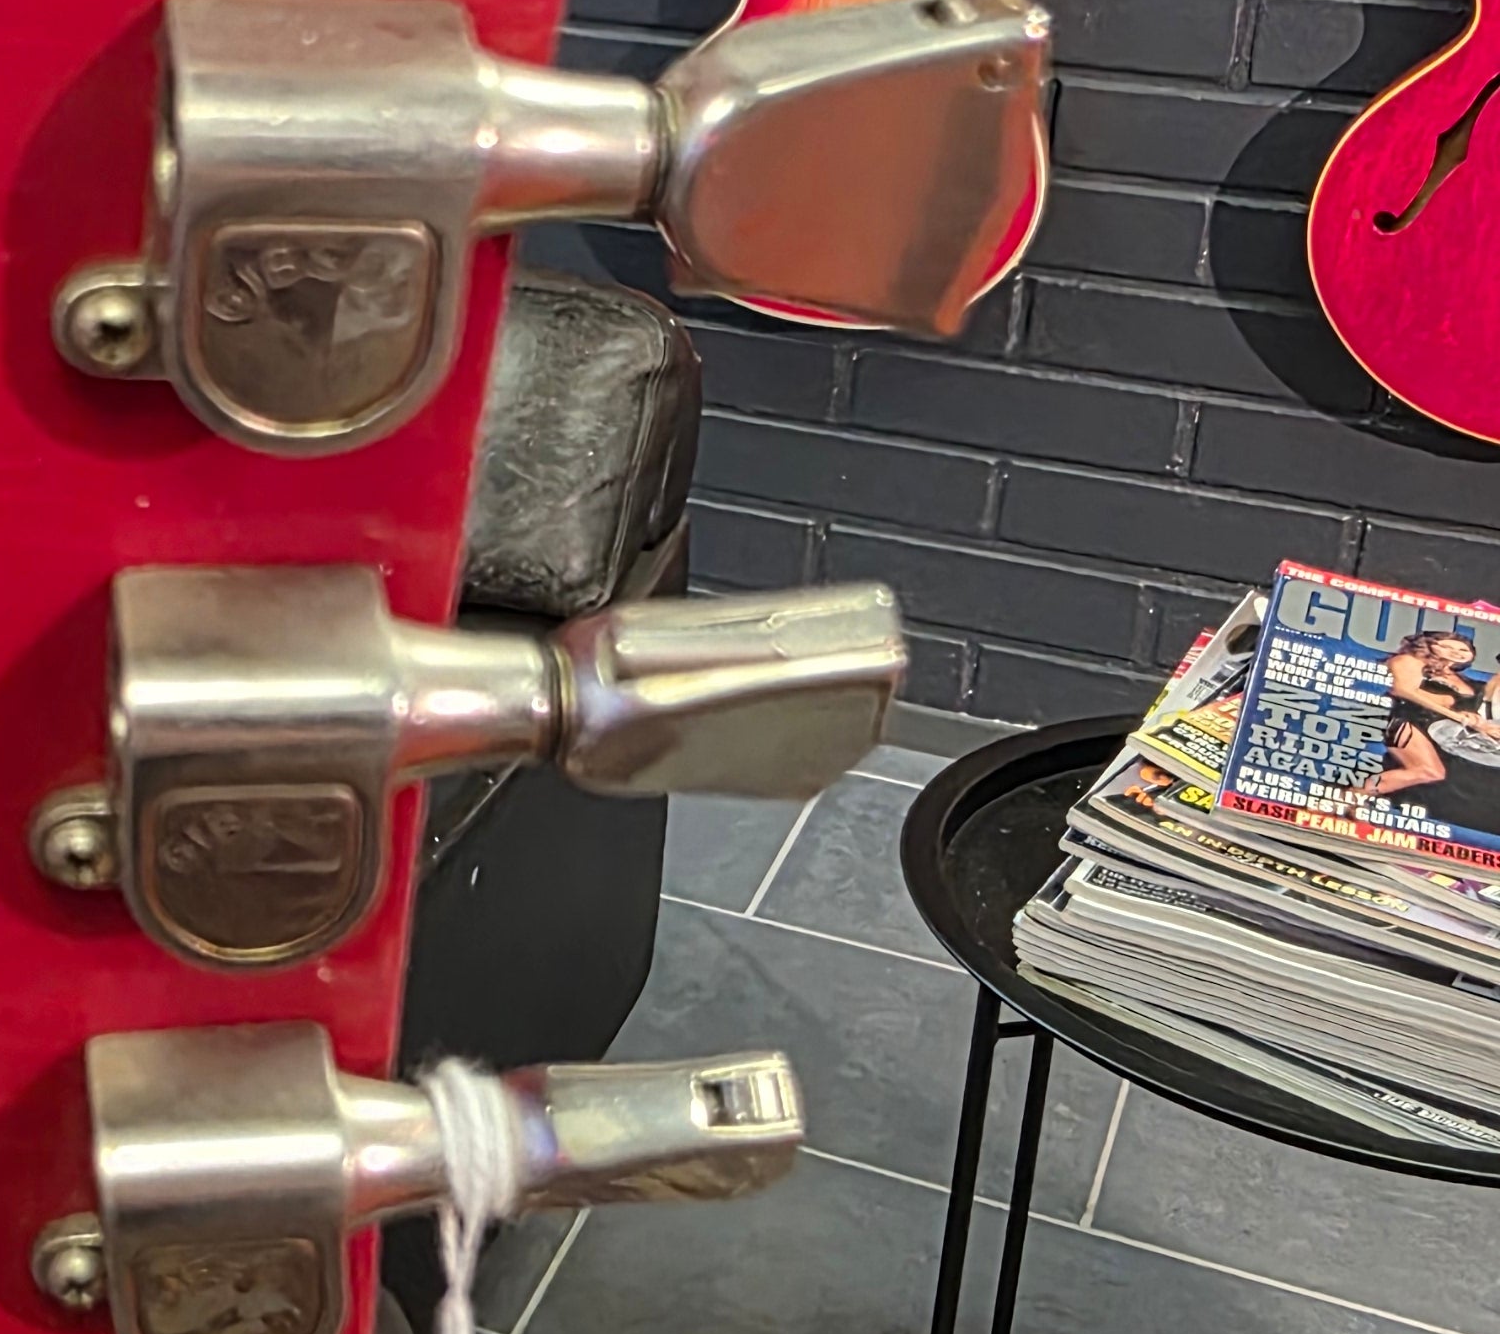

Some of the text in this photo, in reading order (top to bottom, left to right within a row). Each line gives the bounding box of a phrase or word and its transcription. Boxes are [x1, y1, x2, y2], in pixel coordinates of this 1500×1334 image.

[1287, 566, 1324, 583] THE
[1330, 577, 1439, 610] COMPLETE
[1267, 659, 1354, 689] WORLD OF
[1269, 649, 1394, 687] & THE BIZARRE
[1272, 637, 1393, 678] BLUES, BABES,
[1264, 669, 1393, 708] BILLY GIBBONS
[1249, 724, 1385, 774] RIDES
[1257, 702, 1384, 749] TOP
[1236, 779, 1451, 839] WEIRDEST GUITARS
[1239, 766, 1426, 819] PLUS: BILLY'S 10
[1233, 795, 1296, 820] SLASH
[1295, 812, 1358, 838] PEARL
[1367, 828, 1416, 850] JAM
[1158, 820, 1410, 913] AN IN-DEPTH LESSON
